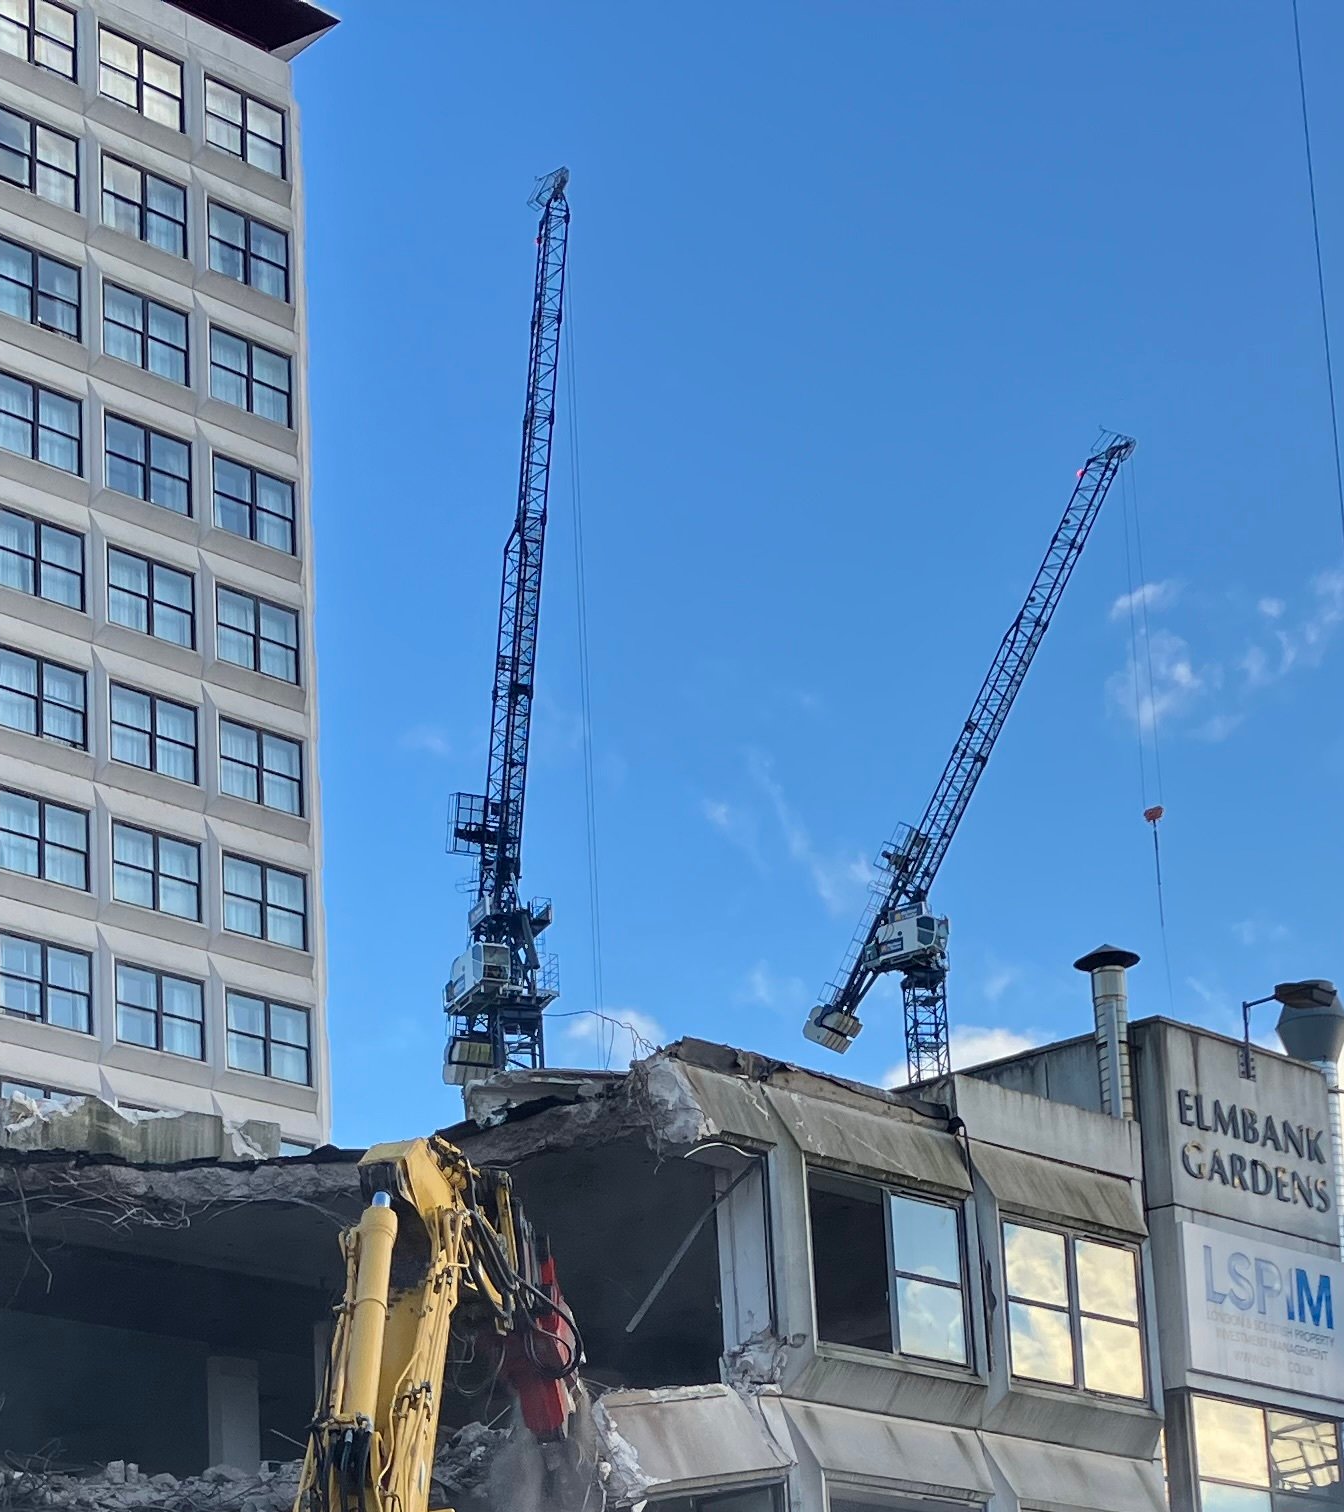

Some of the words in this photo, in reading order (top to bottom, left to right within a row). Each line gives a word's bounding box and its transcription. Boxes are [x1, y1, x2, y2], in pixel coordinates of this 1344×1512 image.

[1178, 1088, 1327, 1165] ELMBANK
[1181, 1140, 1332, 1213] GARDENS
[1207, 1310, 1244, 1328] LONDON
[1294, 1328, 1335, 1347] PROPERTY
[1215, 1326, 1268, 1348] INVESTMENT
[1269, 1337, 1329, 1361] MANAGEMENT
